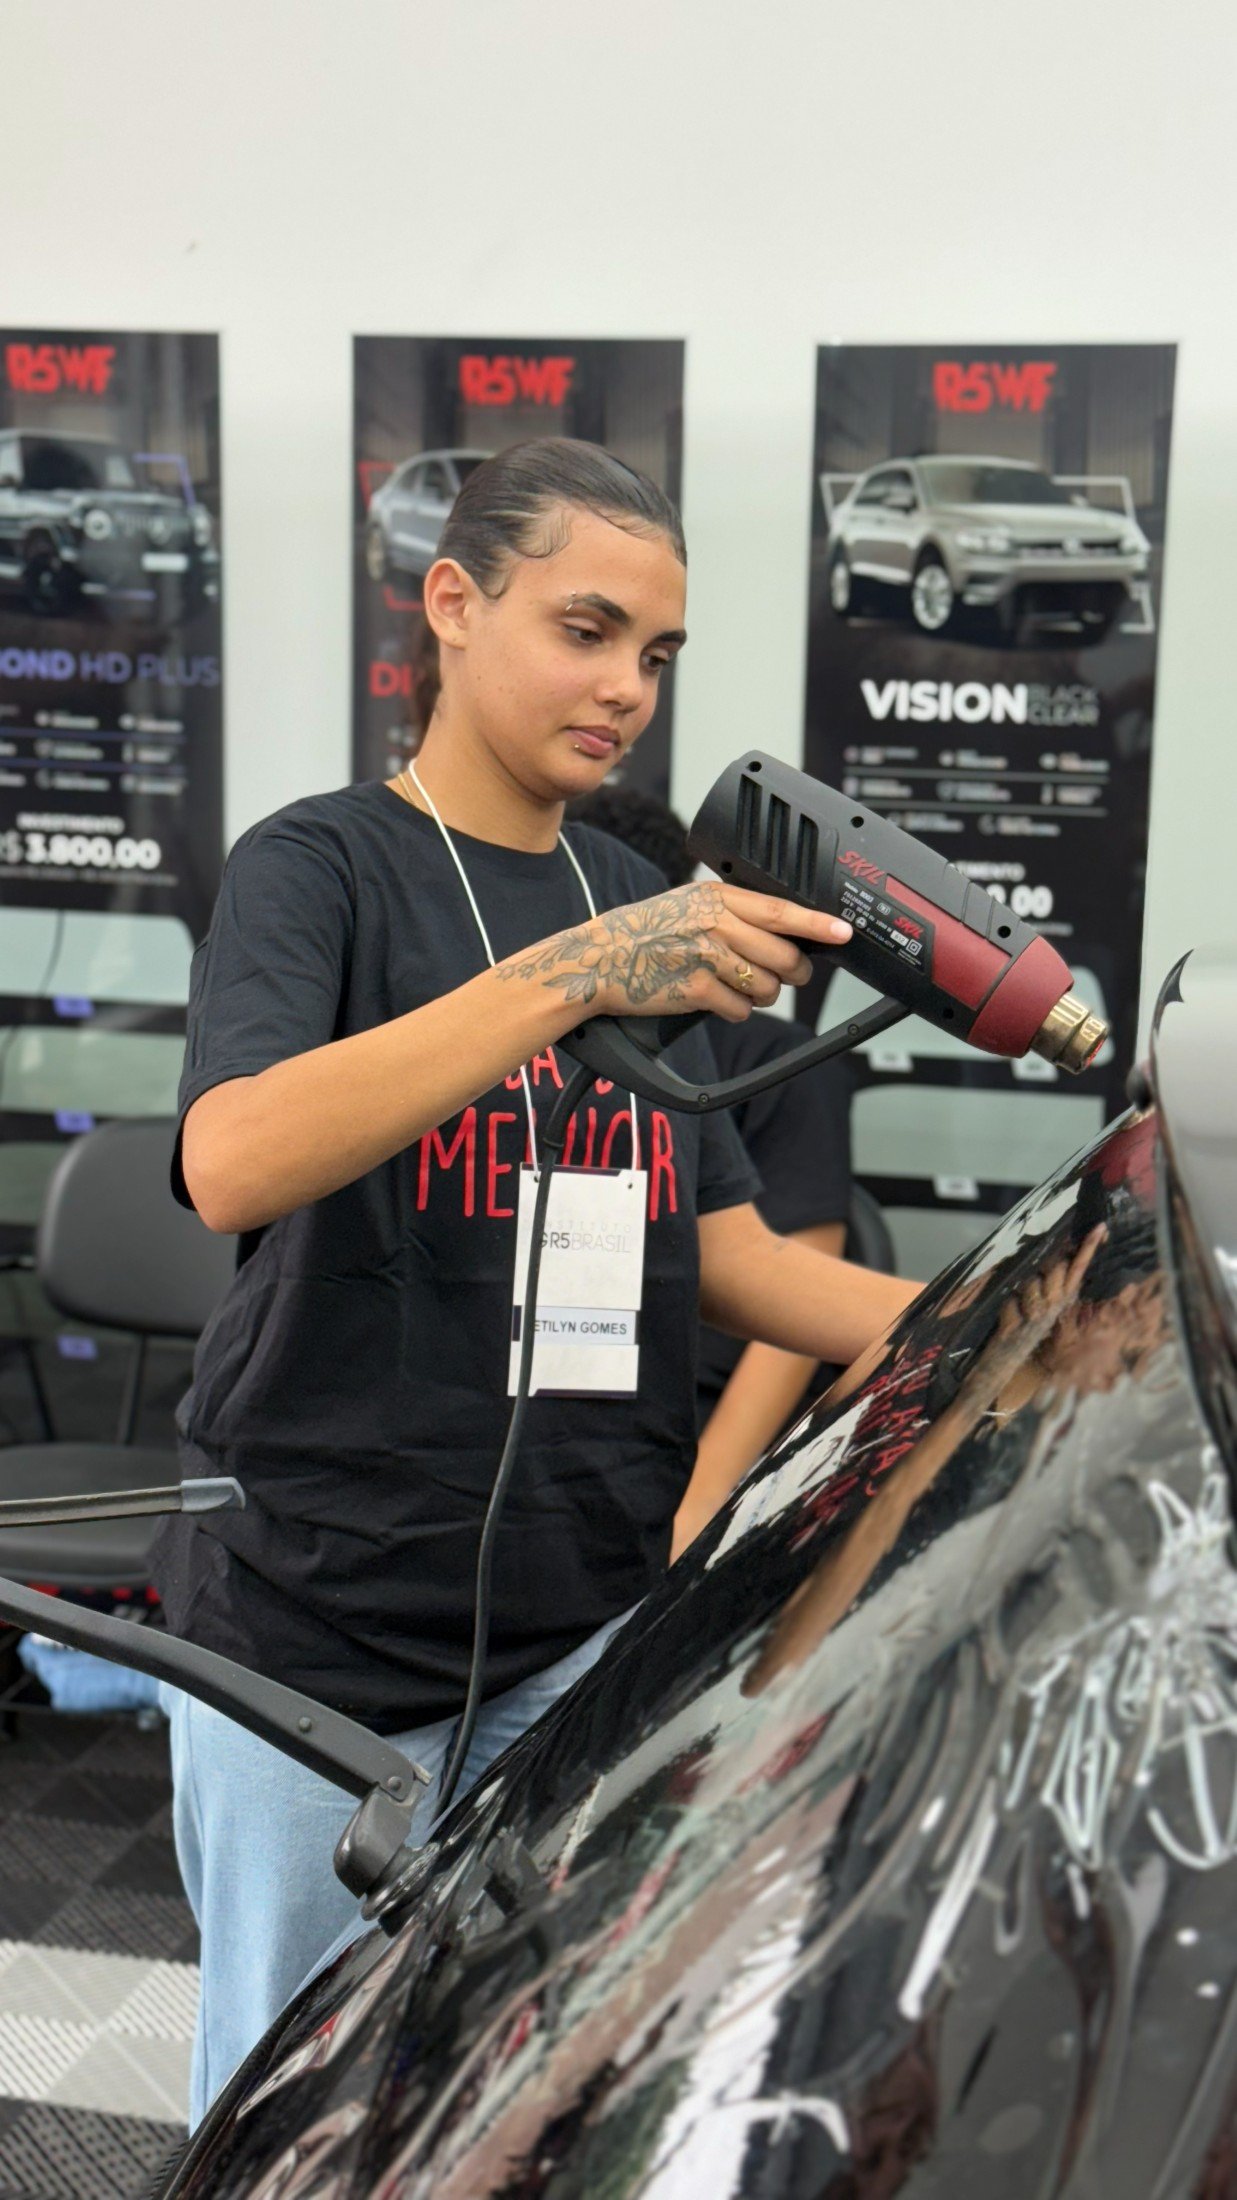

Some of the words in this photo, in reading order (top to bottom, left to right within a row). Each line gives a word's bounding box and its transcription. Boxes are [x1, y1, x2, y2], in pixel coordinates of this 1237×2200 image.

[80, 652, 131, 683] HD
[138, 655, 219, 687] PLUS
[860, 679, 1028, 724] VISION
[1027, 684, 1097, 703] BLACK
[1027, 703, 1097, 726] CLEAR
[837, 851, 885, 886] SKIL
[579, 1321, 628, 1336] GOMES
